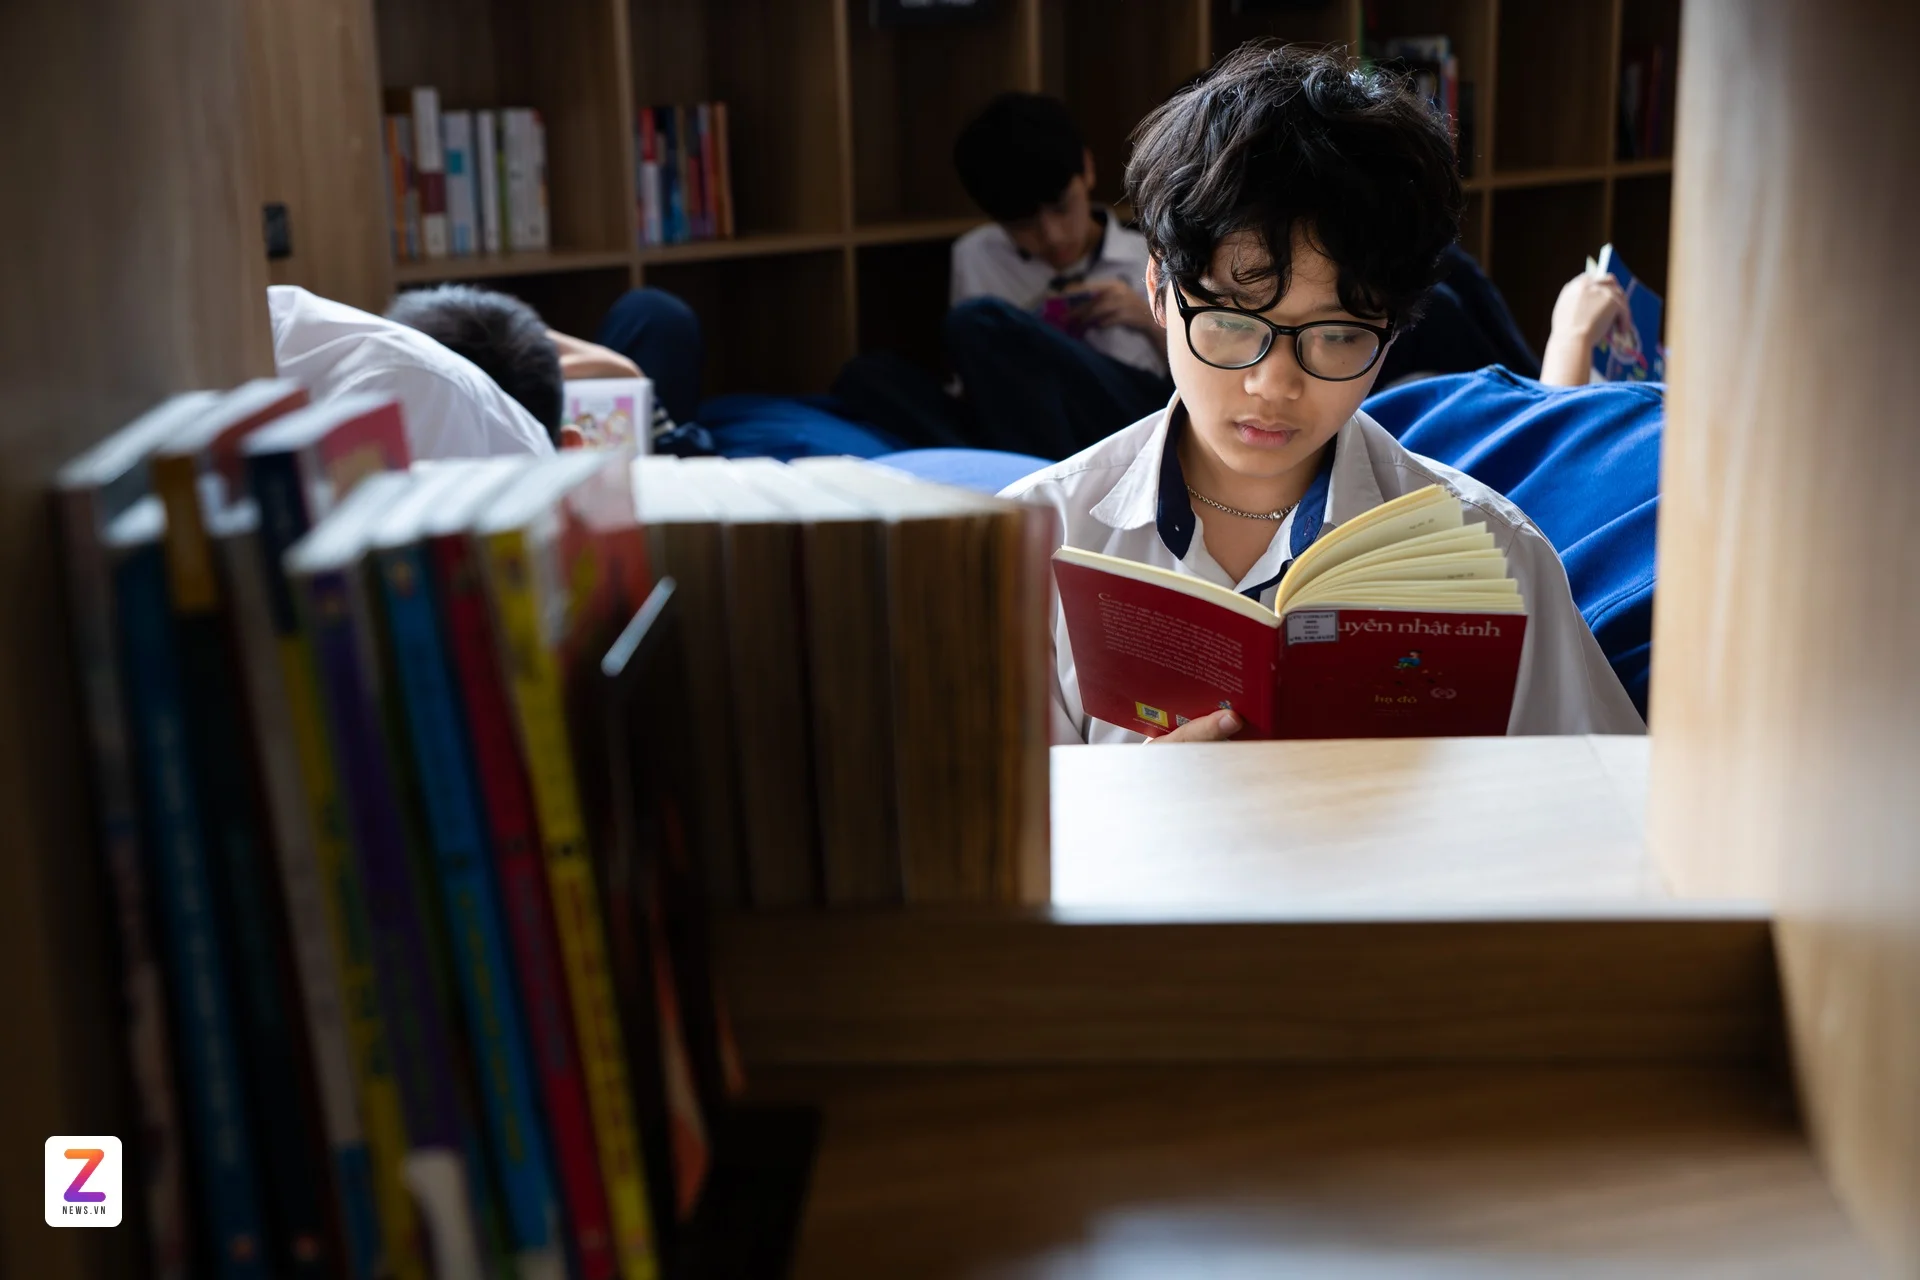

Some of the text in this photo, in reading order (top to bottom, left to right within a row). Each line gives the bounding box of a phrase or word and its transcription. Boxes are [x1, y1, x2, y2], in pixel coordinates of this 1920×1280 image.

[1337, 618, 1501, 637] uyễn nhật ánh
